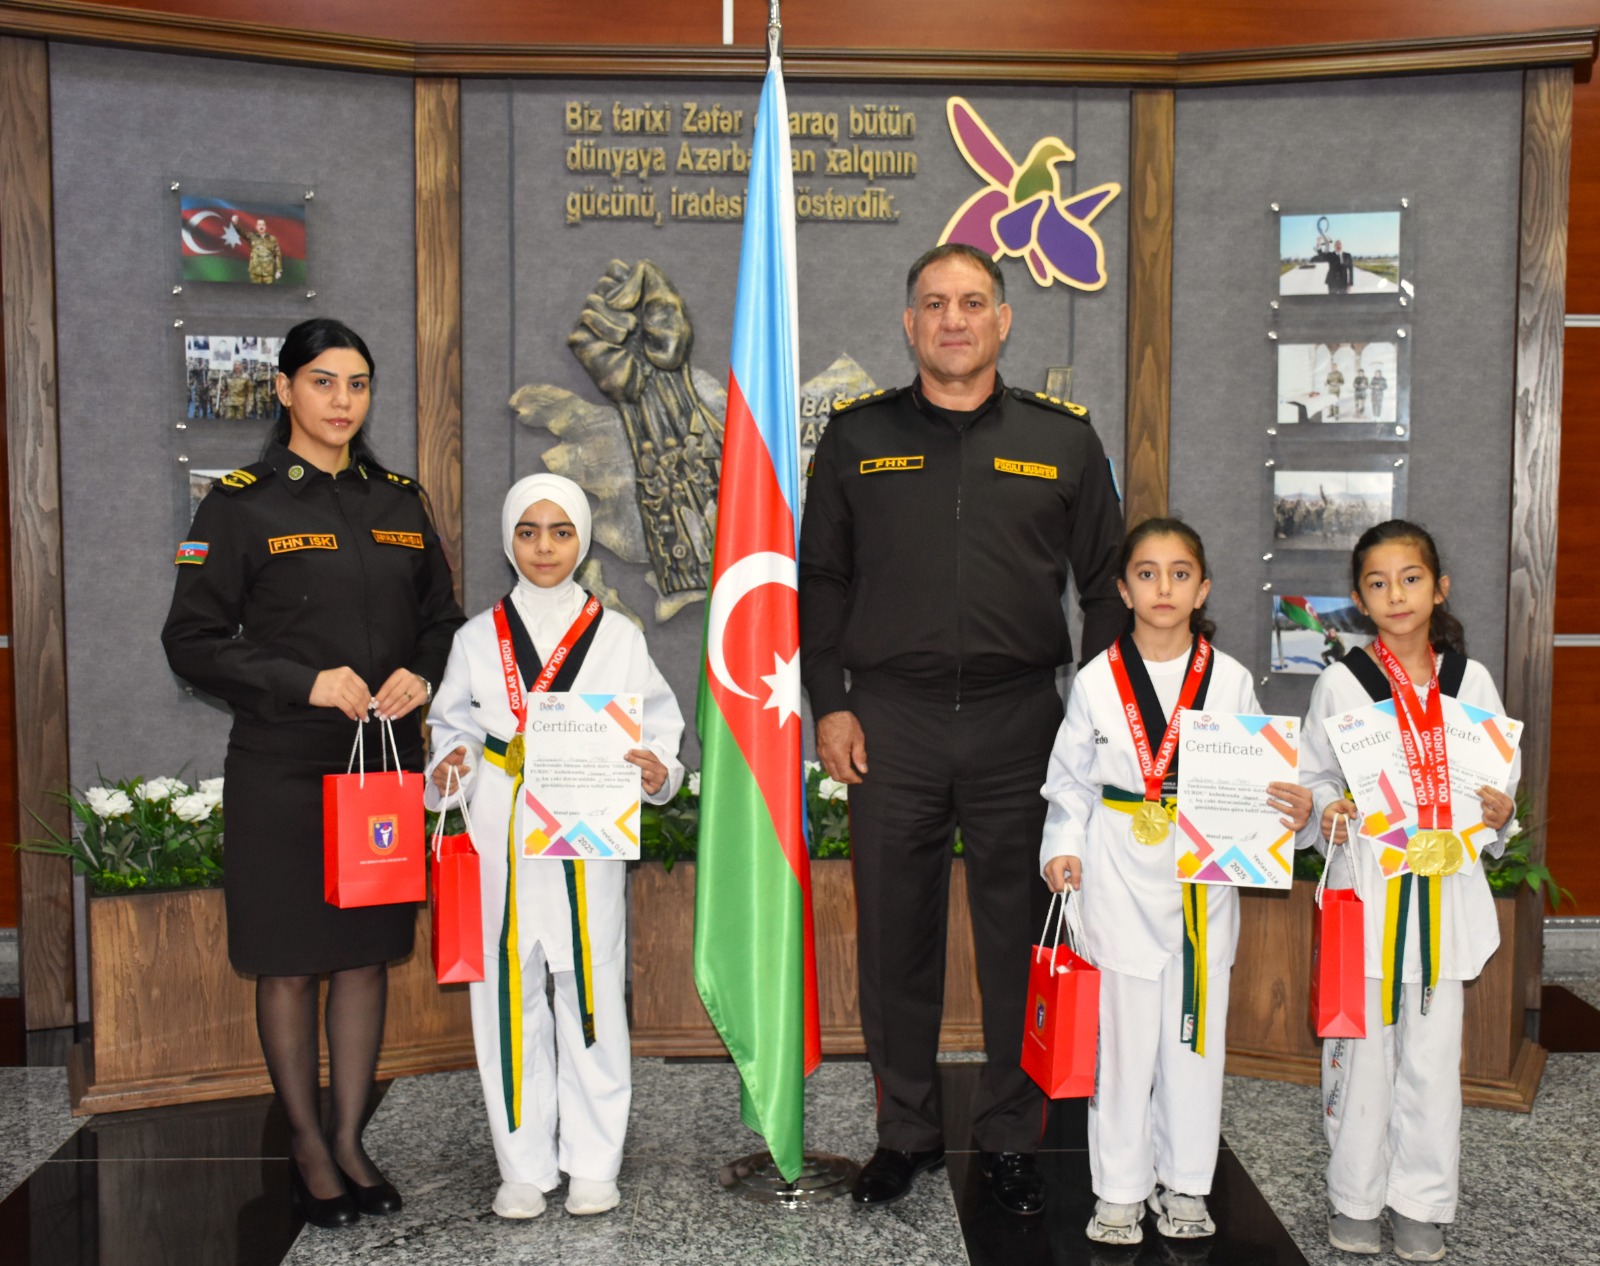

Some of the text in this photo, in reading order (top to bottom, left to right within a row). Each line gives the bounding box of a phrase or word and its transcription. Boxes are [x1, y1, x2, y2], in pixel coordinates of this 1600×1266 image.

[565, 100, 602, 133] Biz
[612, 100, 671, 133] tarixi
[681, 102, 743, 134] Zəfər
[849, 104, 916, 136] bütün
[566, 139, 667, 179] dünyaya
[825, 144, 918, 181] xalqının
[566, 185, 900, 226] gücünü, iradəsi östərdik.
[874, 458, 907, 468] FHN
[273, 537, 303, 551] FHN
[500, 639, 520, 709] ODLAR YURDU
[543, 646, 567, 679] ODLAR
[1385, 656, 1409, 685] YURDU
[532, 720, 608, 733] Certificate
[1125, 703, 1152, 776] ODLAR YURDU
[1340, 730, 1392, 754] Certific
[1153, 741, 1173, 777] ODLAR
[1185, 739, 1264, 757] Certificate
[1402, 730, 1428, 806] ODLAR YURDU
[1433, 727, 1449, 803] ODLAR YURDU
[578, 835, 595, 854] 2025
[1230, 861, 1247, 880] 2025
